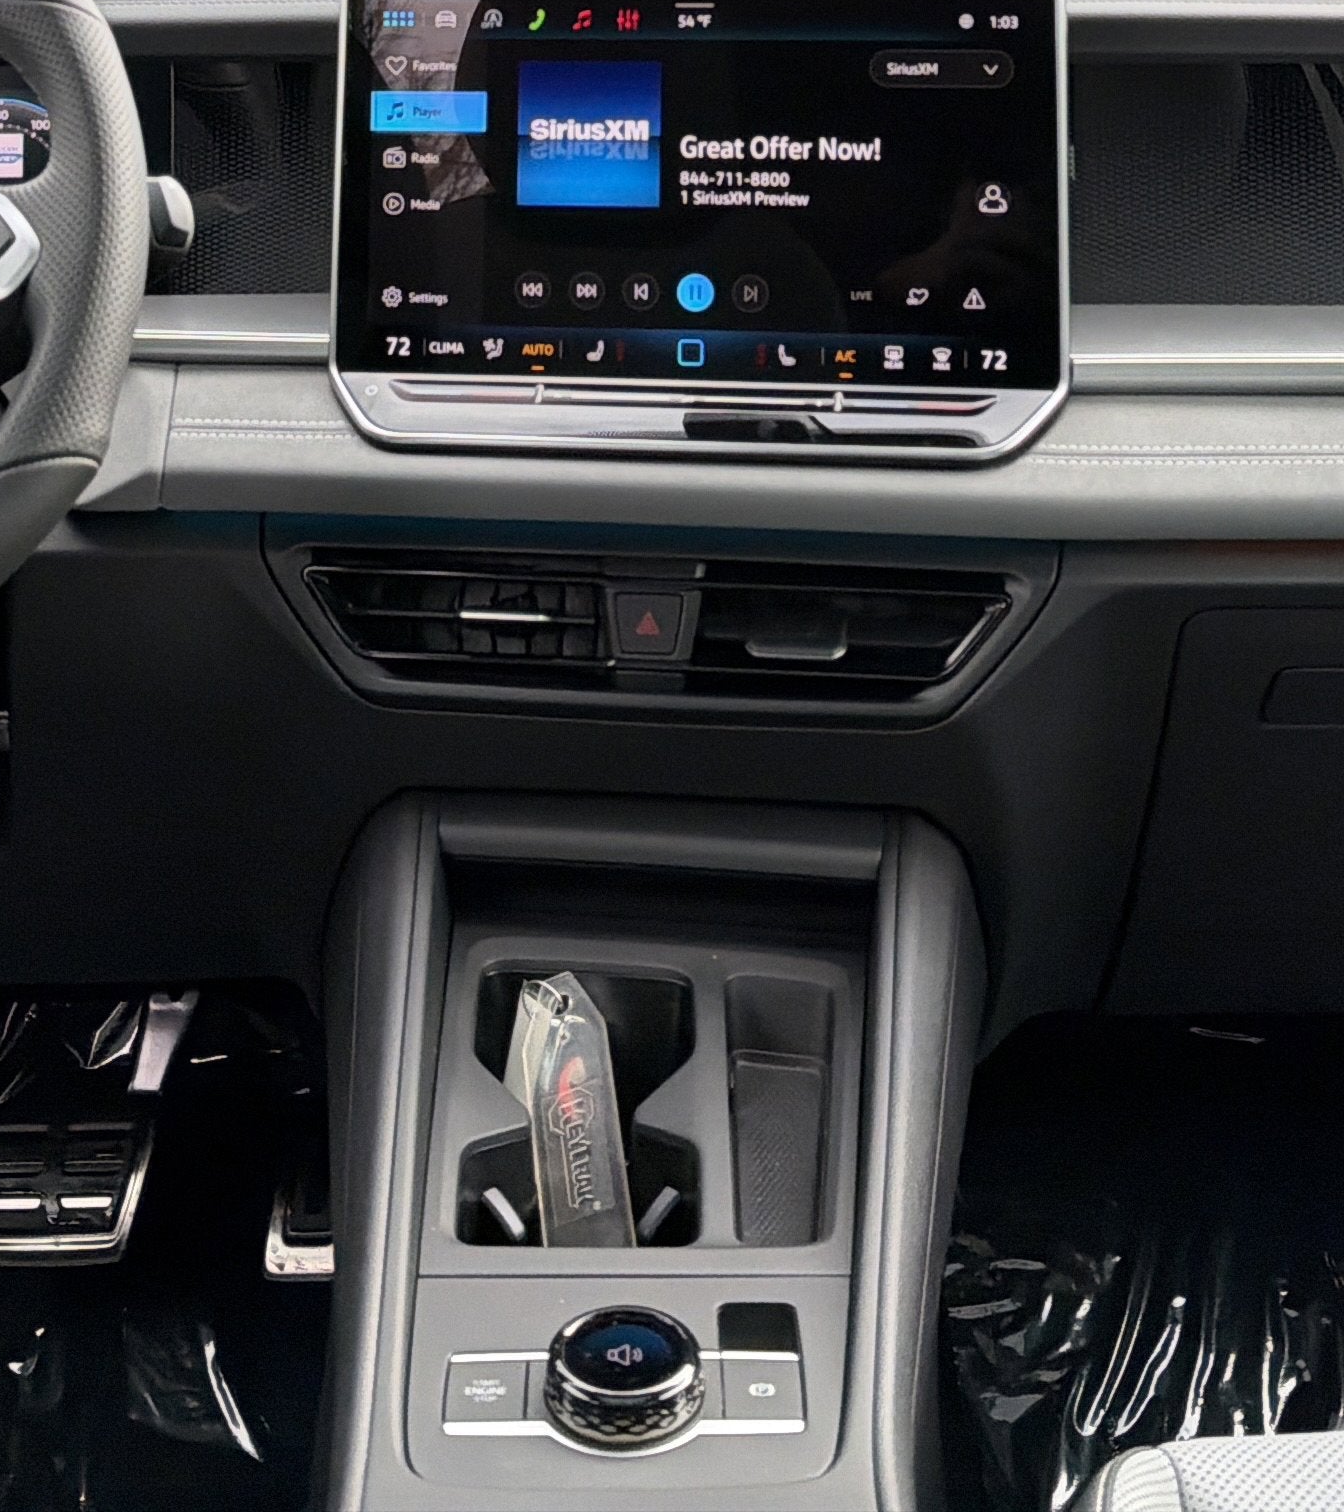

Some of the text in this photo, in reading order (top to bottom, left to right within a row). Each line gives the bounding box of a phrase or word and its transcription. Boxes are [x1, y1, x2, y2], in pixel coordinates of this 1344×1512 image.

[989, 15, 1019, 29] 1:03
[412, 59, 457, 73] Favorites
[886, 62, 939, 76] SiriusXM
[412, 106, 442, 119] Player
[31, 119, 51, 131] 100
[529, 118, 650, 143] SiriusXM
[679, 134, 882, 162] Great Offer Now!
[411, 152, 440, 165] Radio
[679, 170, 791, 187] 844-711-8800
[410, 199, 441, 211] Media
[680, 190, 810, 207] 1 SiriusXM Preview
[408, 291, 449, 307] Settings
[850, 291, 873, 302] LIVE
[385, 336, 411, 356] 72
[429, 341, 464, 355] CLIMA
[522, 343, 555, 356] AUTO
[834, 349, 857, 364] A/C
[980, 349, 1008, 371] 72
